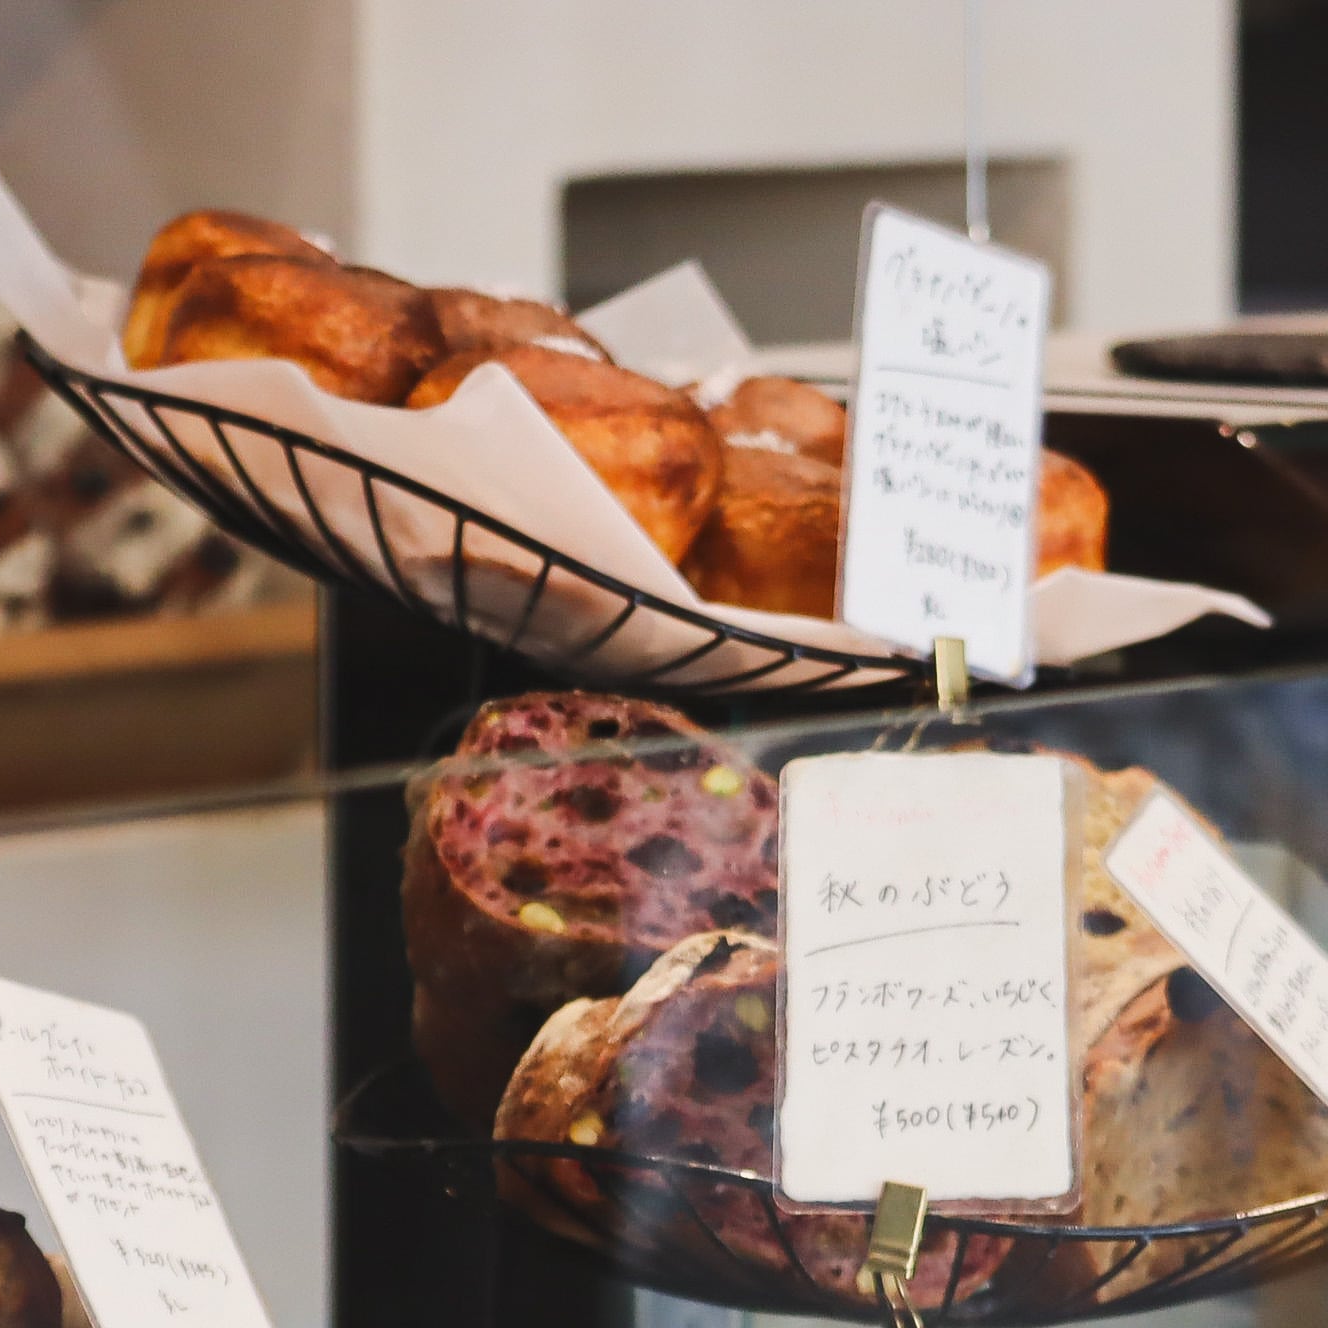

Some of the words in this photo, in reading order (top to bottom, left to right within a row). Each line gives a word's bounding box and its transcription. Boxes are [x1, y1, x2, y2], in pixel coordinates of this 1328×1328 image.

[817, 872, 1012, 914] 秋のぶどう
